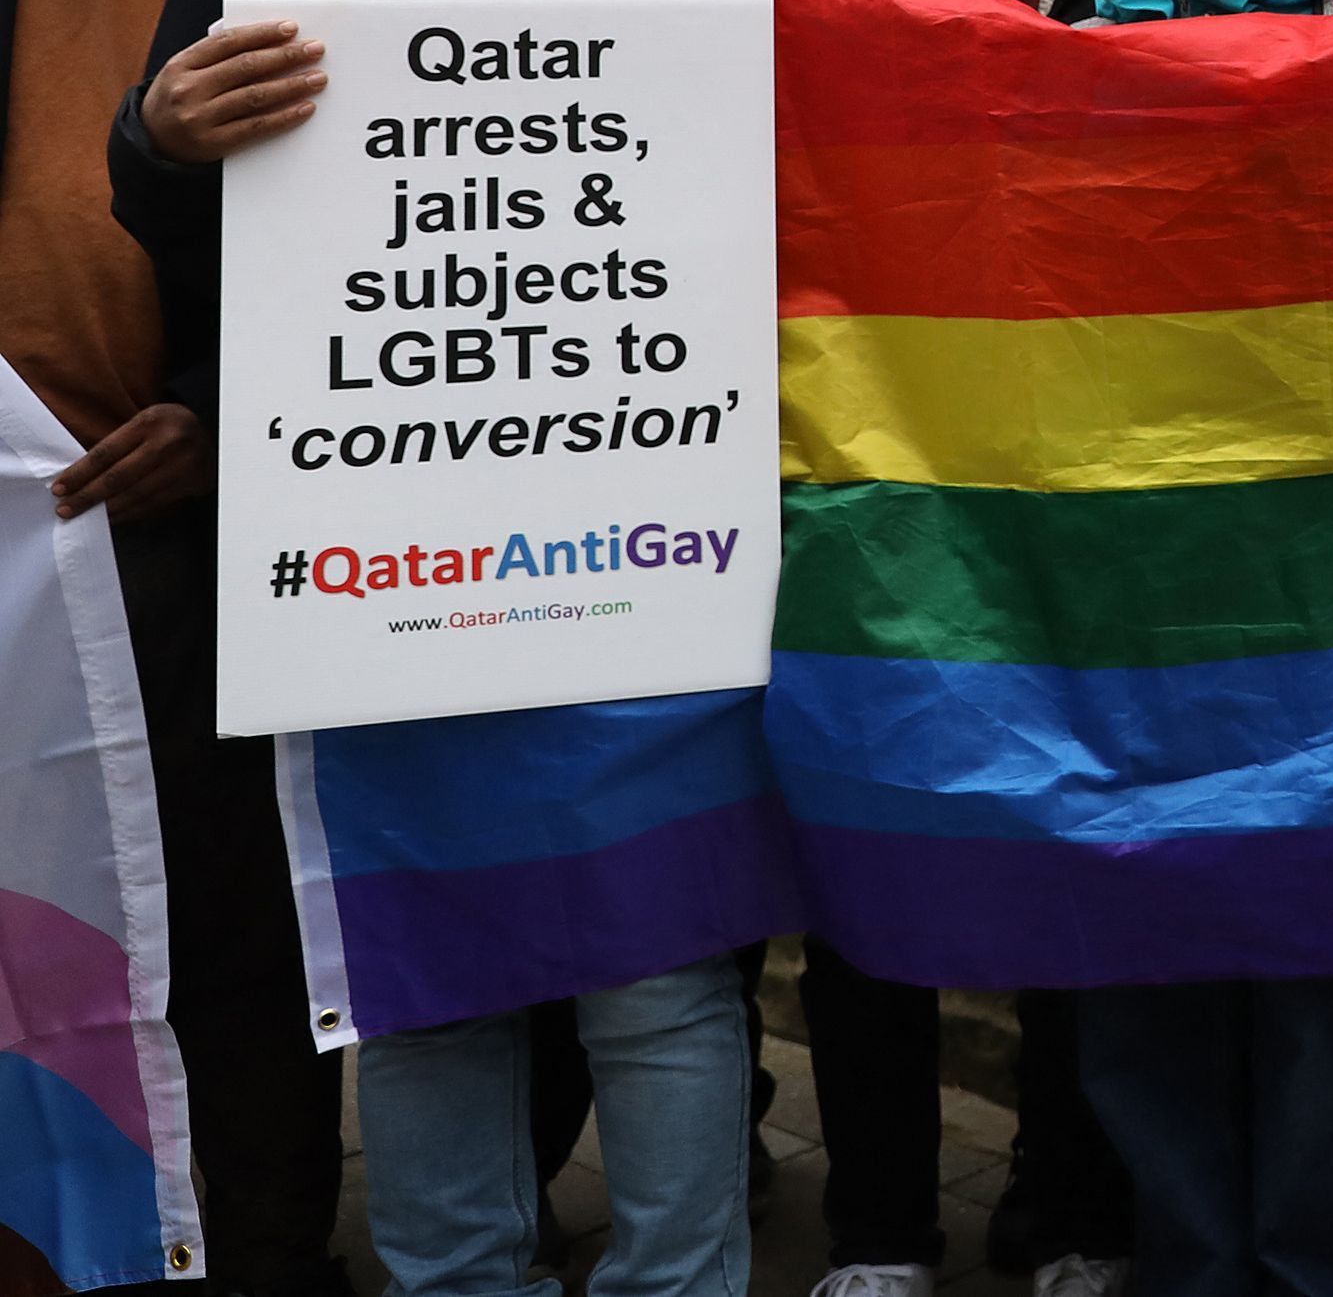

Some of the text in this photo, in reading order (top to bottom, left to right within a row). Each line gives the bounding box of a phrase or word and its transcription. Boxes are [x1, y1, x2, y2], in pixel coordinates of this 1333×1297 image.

[408, 28, 614, 85] Qatar
[366, 102, 647, 161] arrests,
[386, 173, 626, 249] jails &
[345, 249, 667, 320] subjects
[330, 323, 686, 390] LGBTs to
[269, 390, 738, 470] ‘conversion’
[270, 524, 738, 598] #QatarAntiGay
[389, 602, 631, 632] www.QatarAntiGay.com
